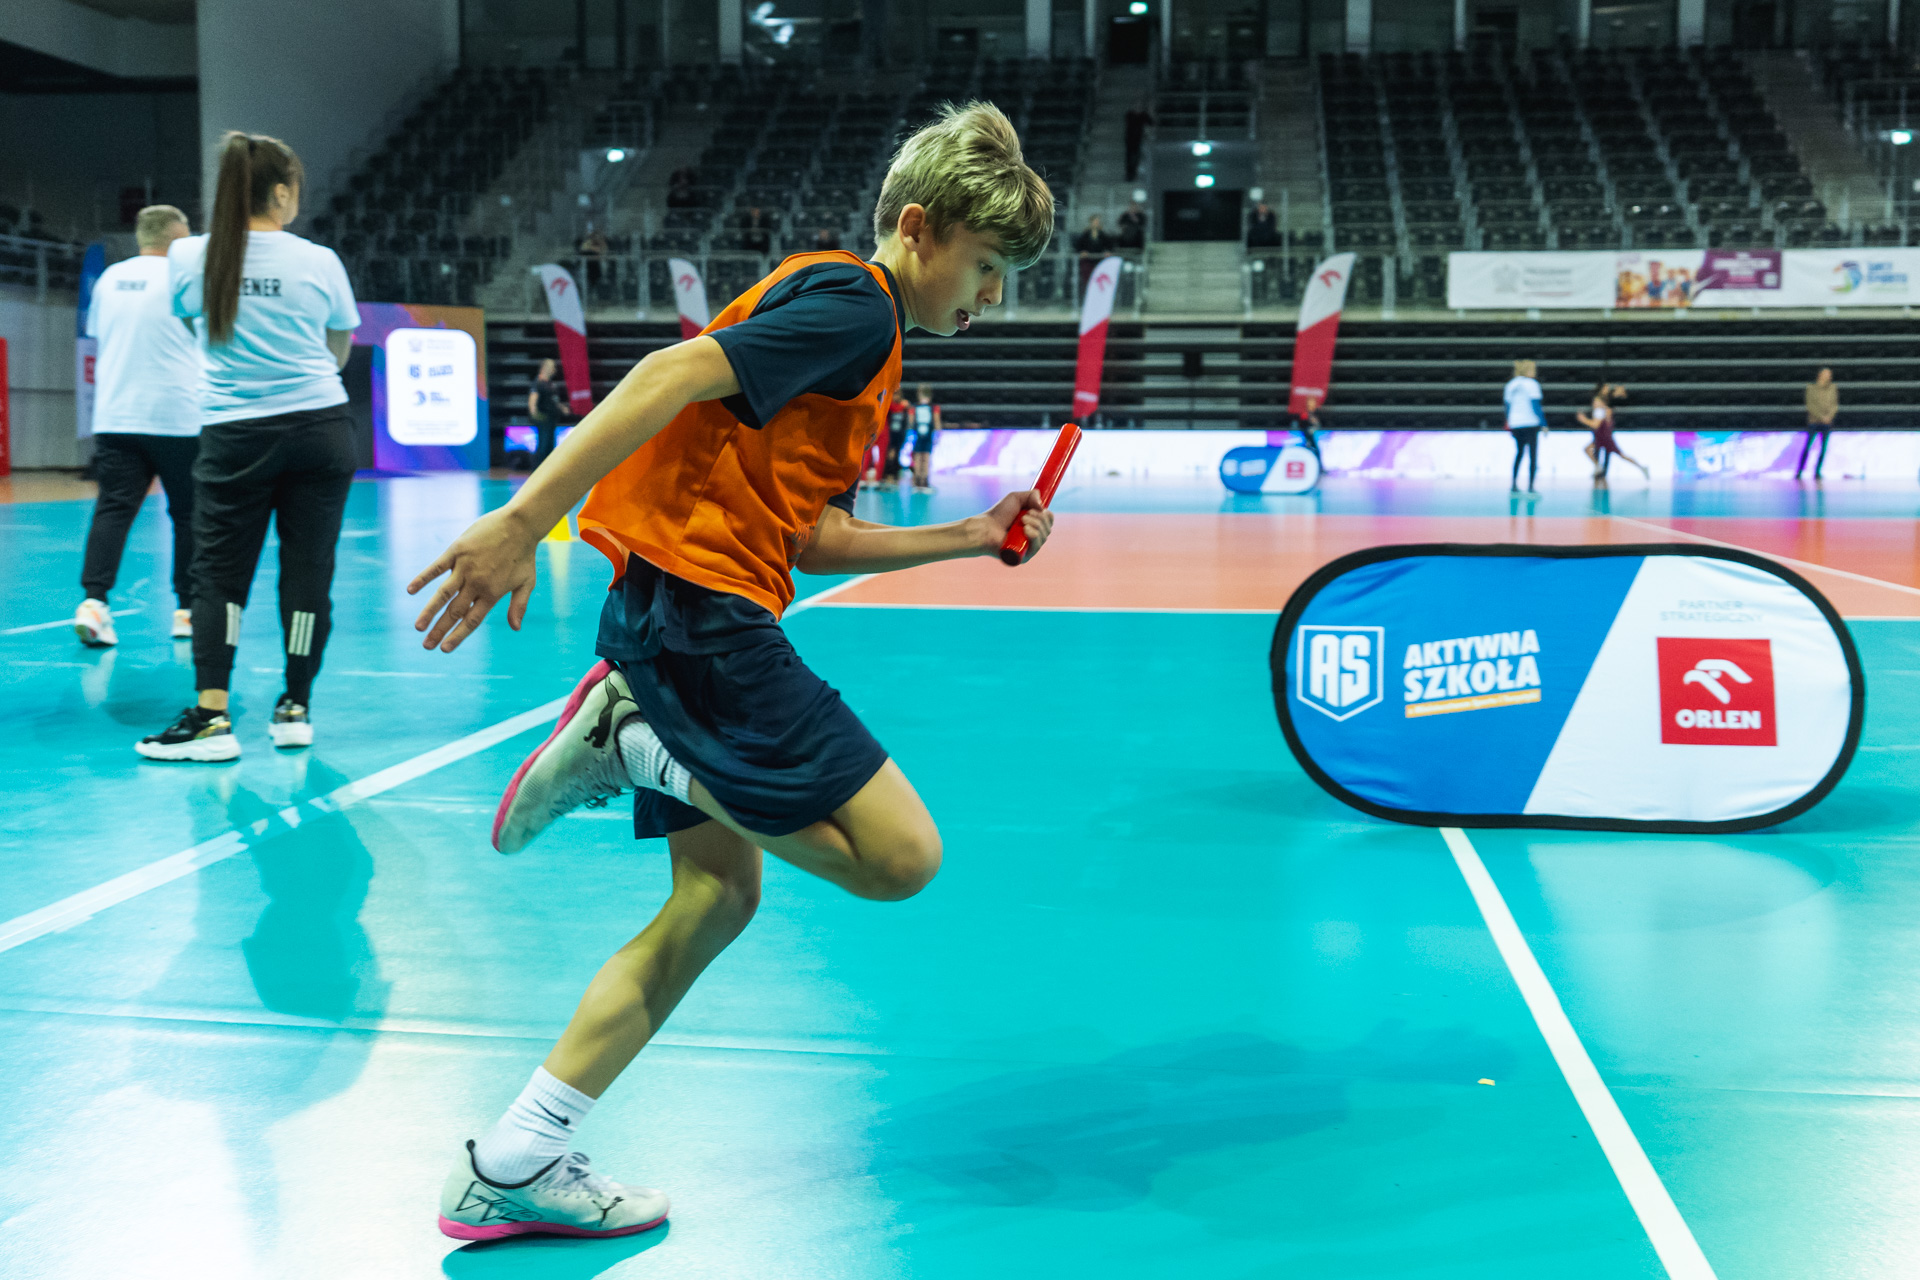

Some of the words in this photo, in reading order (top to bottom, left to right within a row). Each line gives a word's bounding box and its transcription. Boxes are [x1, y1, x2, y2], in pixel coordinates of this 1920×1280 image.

[242, 277, 282, 297] ENER
[1678, 599, 1744, 611] PARTNER
[1403, 629, 1541, 670] AKTYWNA
[1310, 633, 1371, 708] AS
[1403, 655, 1542, 703] SZKOŁA
[1675, 708, 1762, 729] ORLEN
